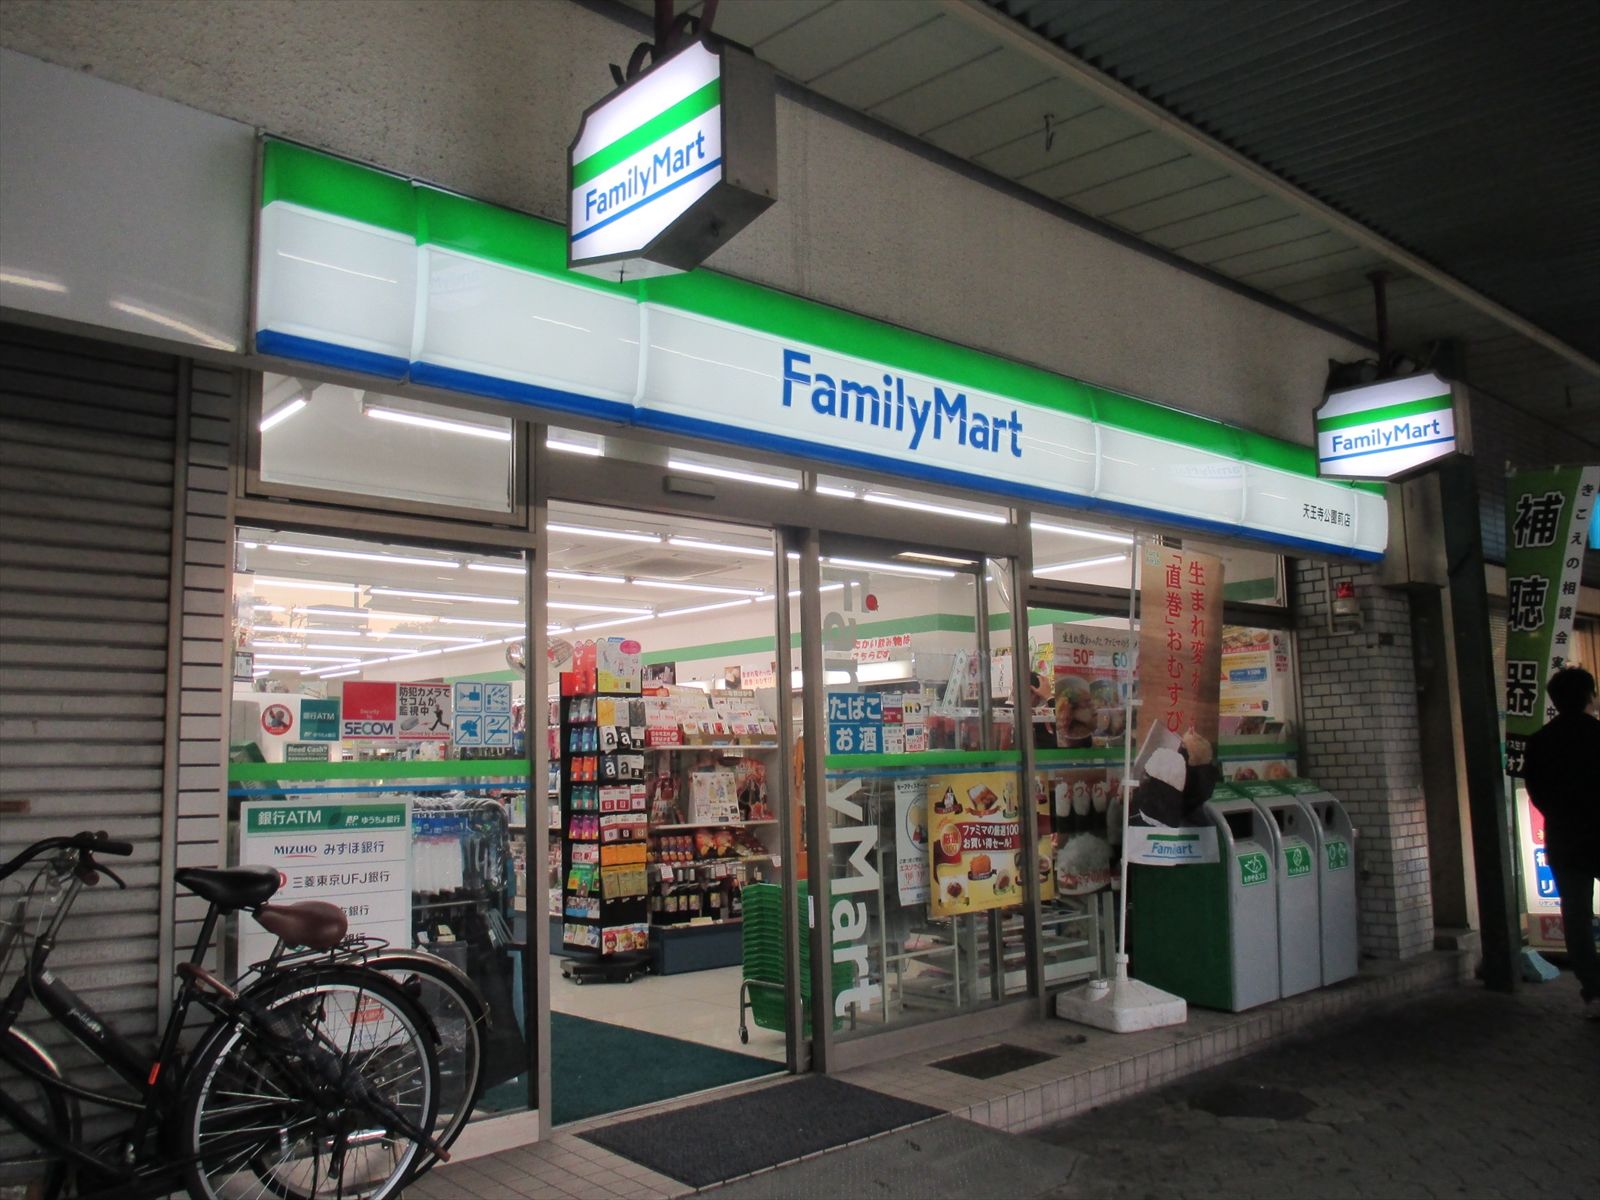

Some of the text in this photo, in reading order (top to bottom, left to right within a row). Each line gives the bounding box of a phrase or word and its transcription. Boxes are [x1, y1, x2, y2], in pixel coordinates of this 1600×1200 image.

[586, 130, 705, 221] FamilyMart
[782, 348, 1022, 458] FamilyMart
[1332, 419, 1440, 452] FamilyMart
[1507, 491, 1565, 717] 補聴器
[1547, 484, 1594, 719] きこえの相談会実中
[400, 687, 450, 697] 防犯カメラで
[400, 697, 436, 707] セコムが
[400, 706, 429, 716] 監視中
[830, 696, 882, 720] たばこ
[344, 722, 393, 735] SECOM
[836, 727, 877, 752] お酒
[258, 811, 321, 825] 銀行ATM
[274, 841, 385, 855] MIZUHO みずほ銀行
[293, 871, 391, 888] 三菱東京UFJ銀行
